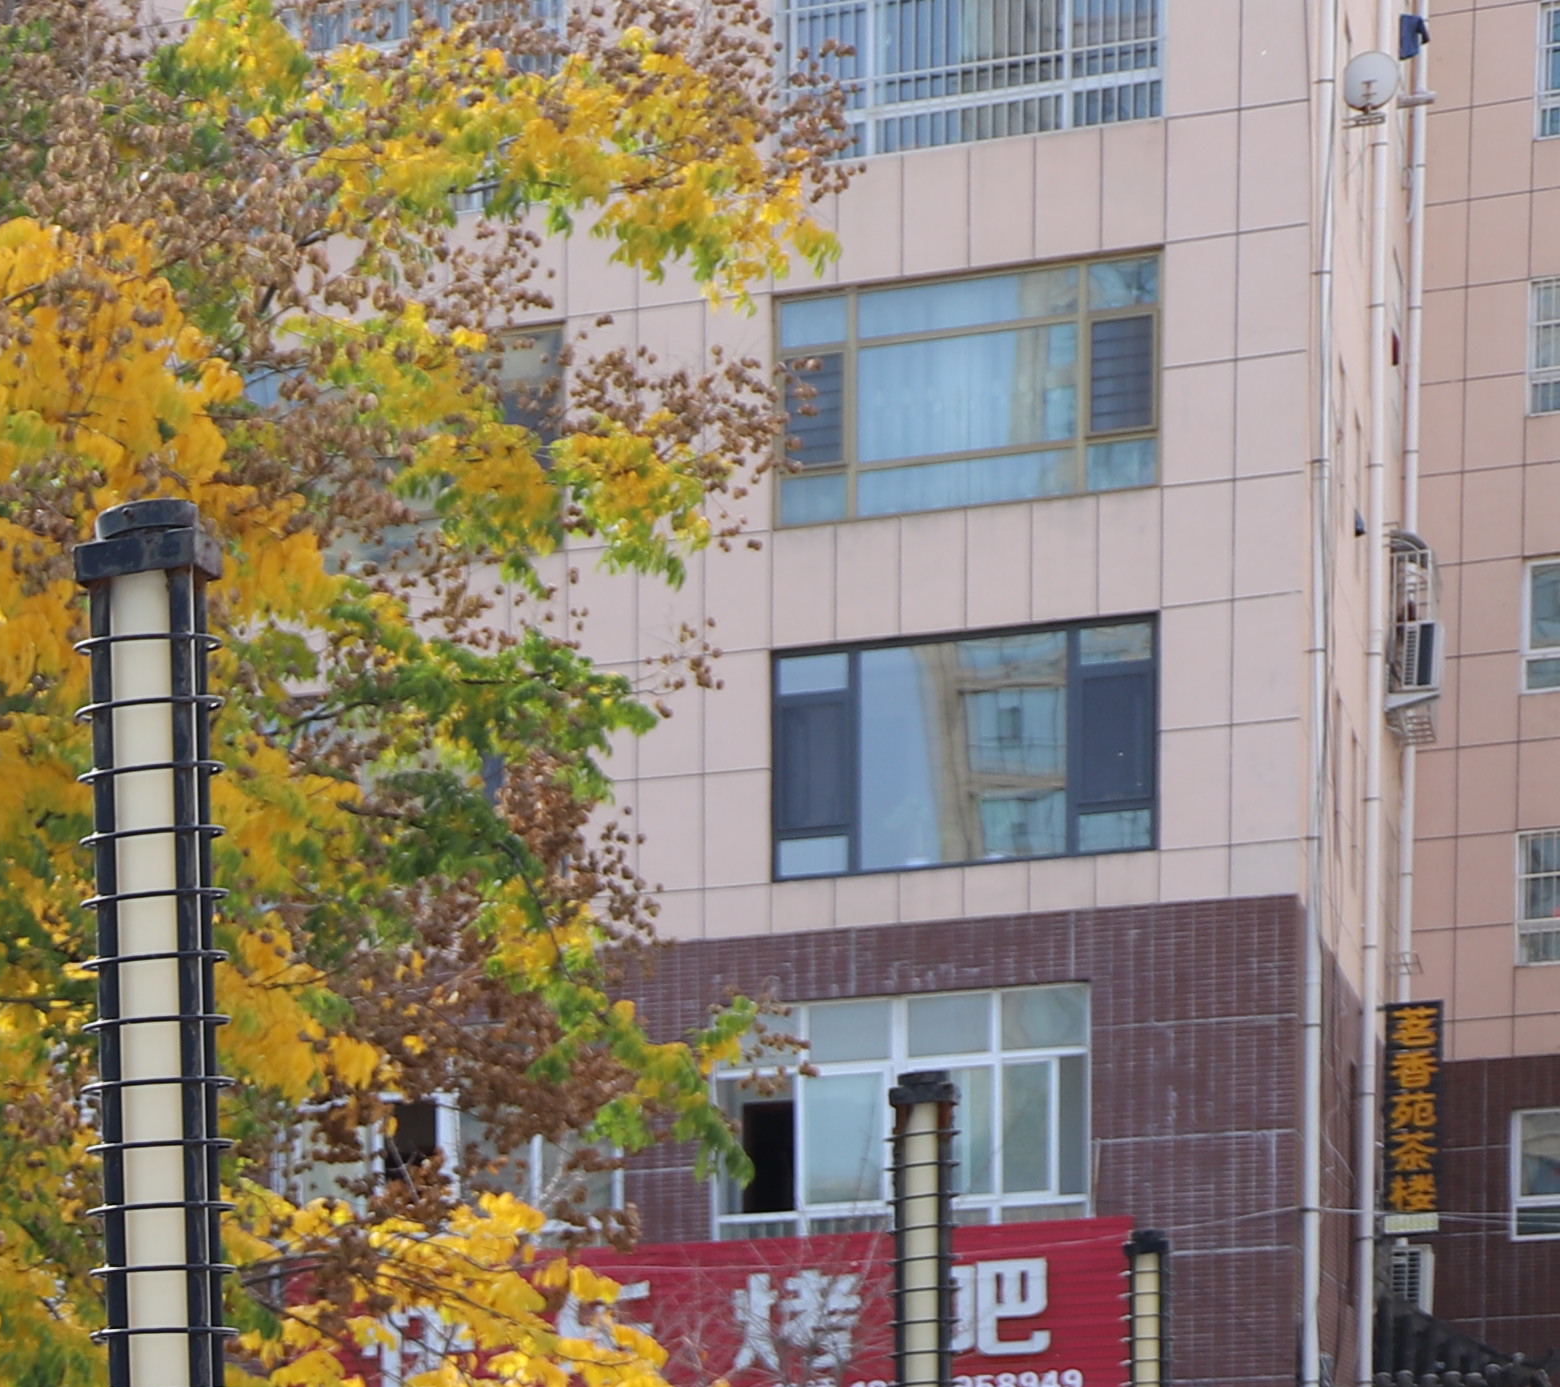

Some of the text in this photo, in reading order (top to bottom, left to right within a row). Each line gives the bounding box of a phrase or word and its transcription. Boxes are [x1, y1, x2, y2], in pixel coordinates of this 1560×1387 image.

[1388, 1007, 1439, 1211] 茗香苑茶楼
